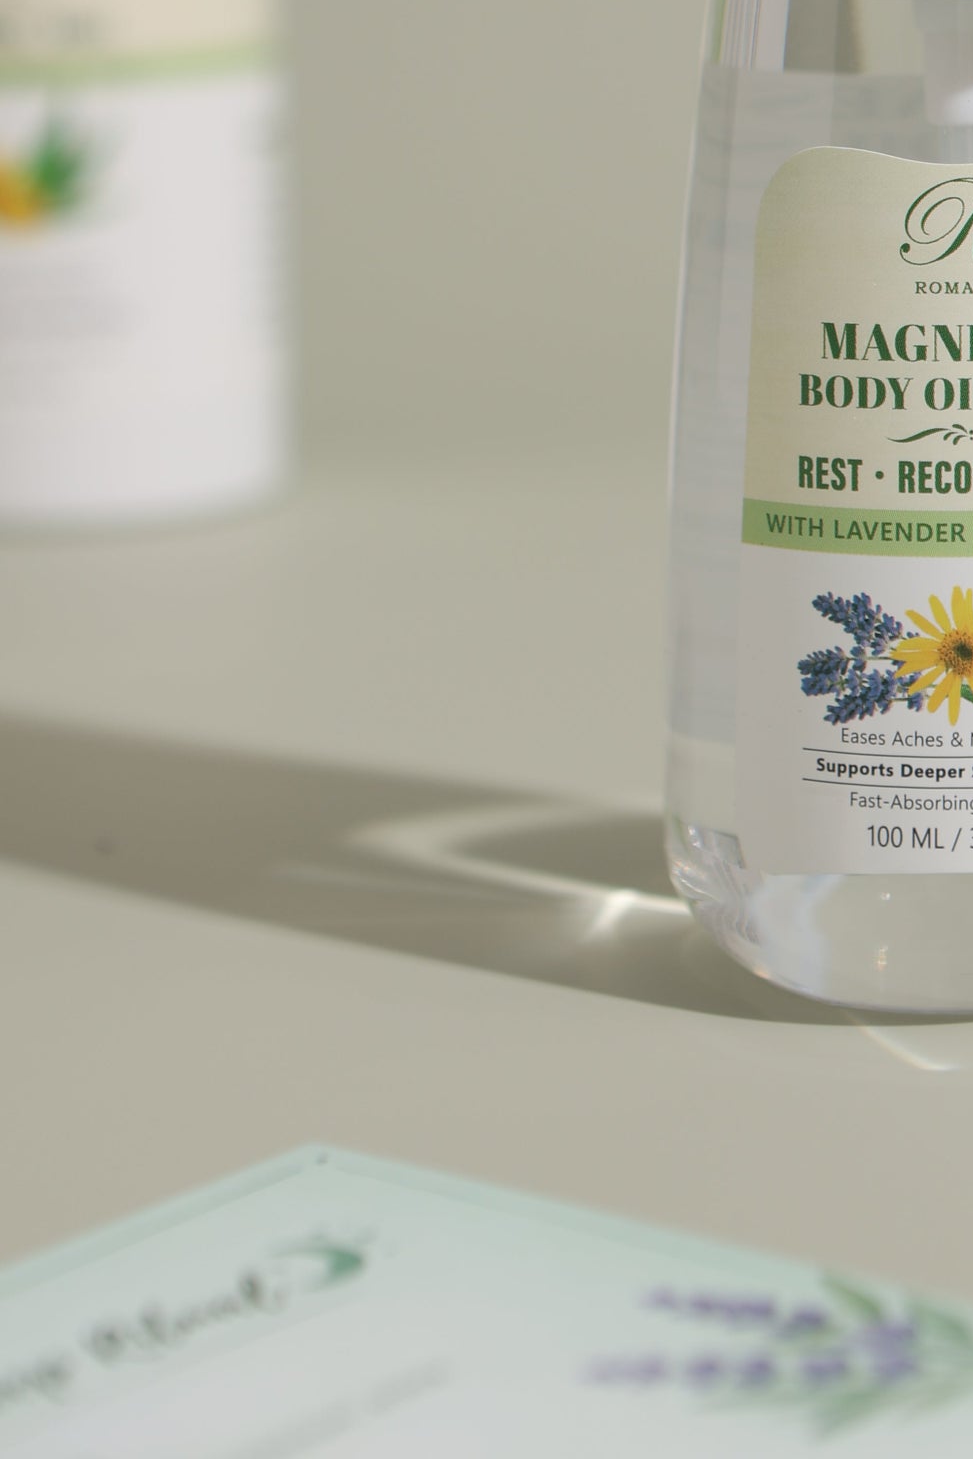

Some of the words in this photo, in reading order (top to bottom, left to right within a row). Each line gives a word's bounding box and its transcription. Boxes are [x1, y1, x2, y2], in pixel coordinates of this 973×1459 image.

[798, 374, 913, 410] BODY
[798, 455, 862, 491] REST
[766, 512, 823, 537] WITH
[834, 519, 966, 542] LAVENDER
[841, 727, 885, 746] Eases
[892, 730, 943, 747] Aches
[950, 731, 963, 747] &
[816, 758, 894, 777] Supports
[901, 763, 965, 781] Deeper
[866, 825, 903, 847] 100
[912, 826, 945, 849] ML
[952, 827, 962, 852] /
